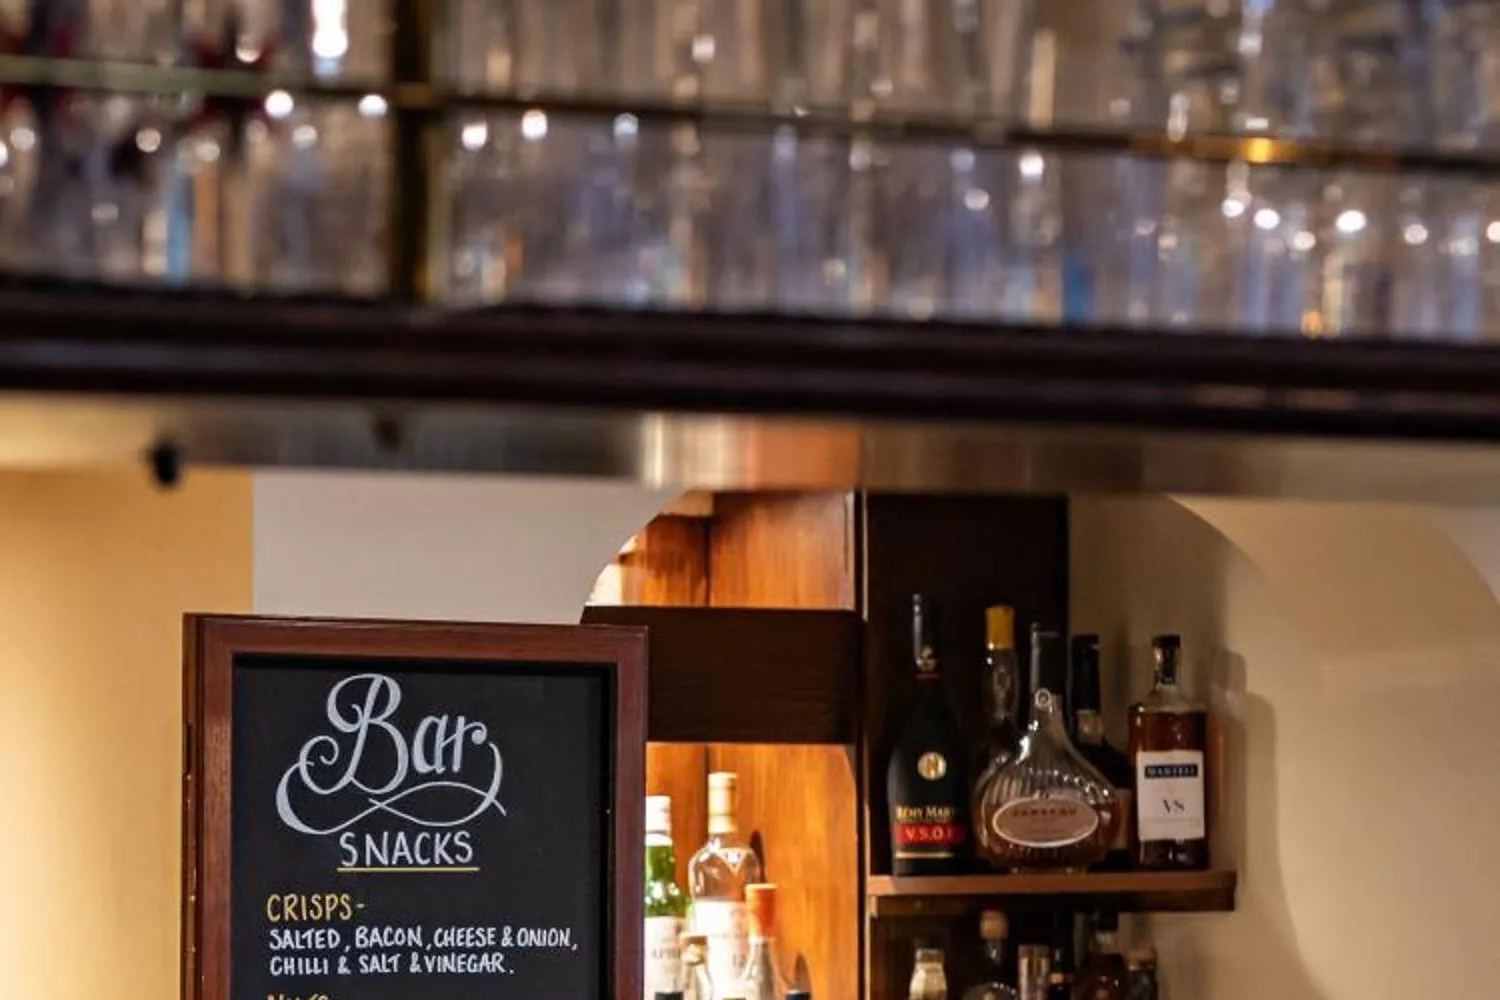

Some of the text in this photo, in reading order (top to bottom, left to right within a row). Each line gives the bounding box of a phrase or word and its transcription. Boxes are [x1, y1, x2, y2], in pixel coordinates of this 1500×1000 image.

[285, 673, 498, 820] Bar
[340, 830, 473, 867] SNACKS
[433, 926, 497, 949] CHEESE
[500, 925, 515, 948] &
[269, 955, 329, 977] CHILLI
[337, 955, 352, 975] &
[358, 953, 402, 974] SALT
[409, 951, 423, 974] &
